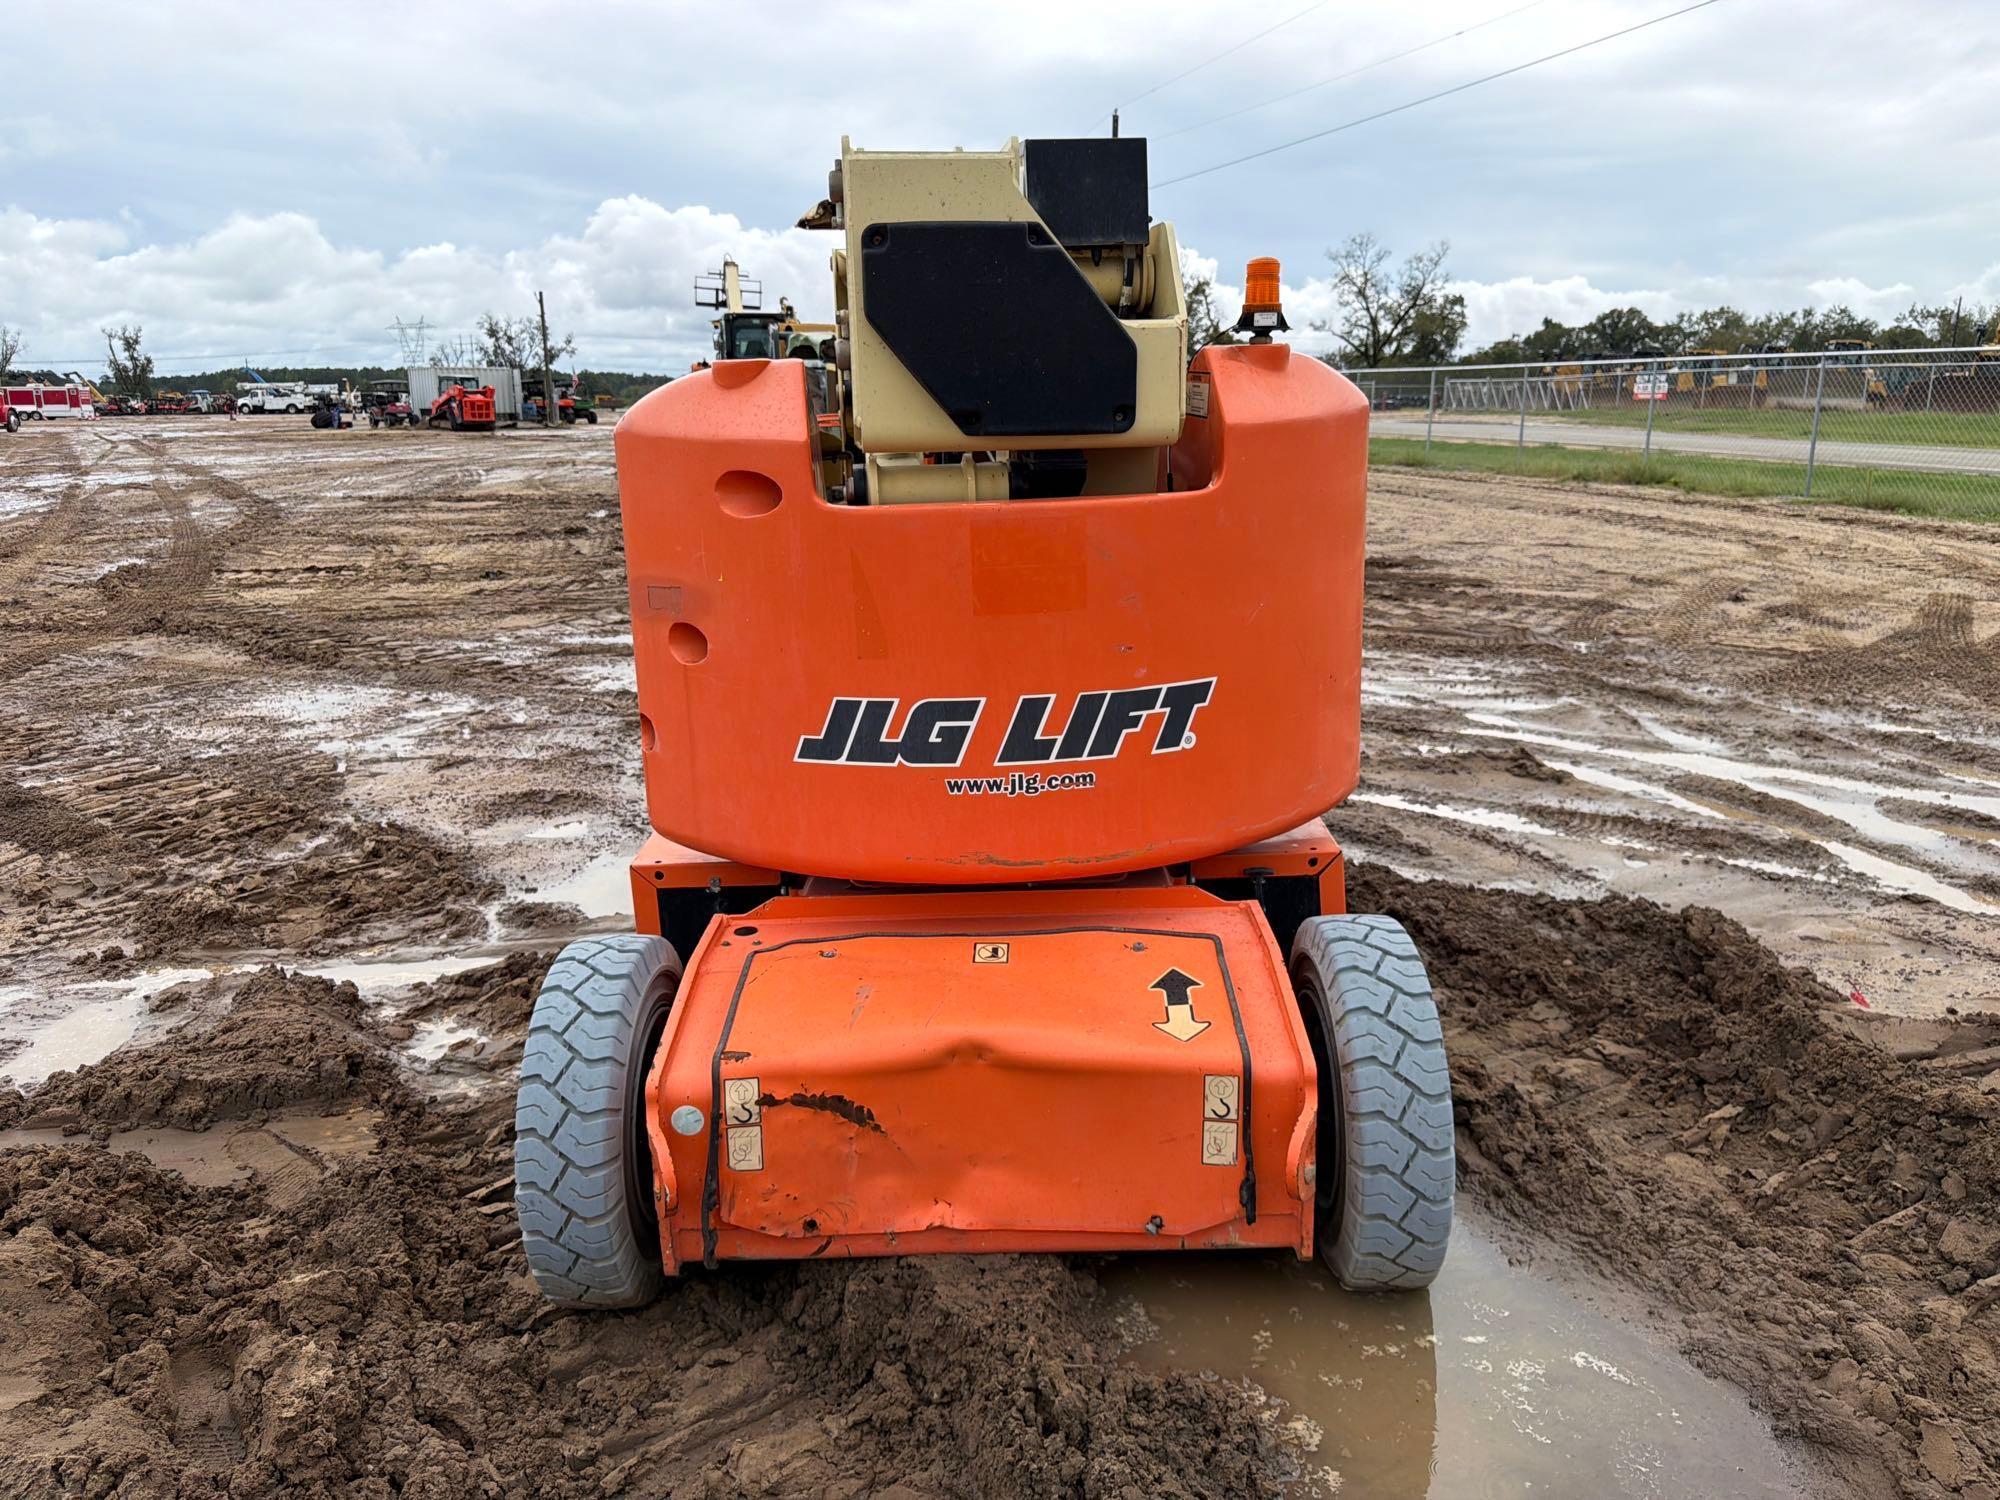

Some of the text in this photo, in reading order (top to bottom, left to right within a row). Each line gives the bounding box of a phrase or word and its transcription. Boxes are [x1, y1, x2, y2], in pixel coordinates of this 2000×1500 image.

[794, 676, 1218, 767] JLG LIFT
[946, 770, 1095, 796] www.jlg.com
